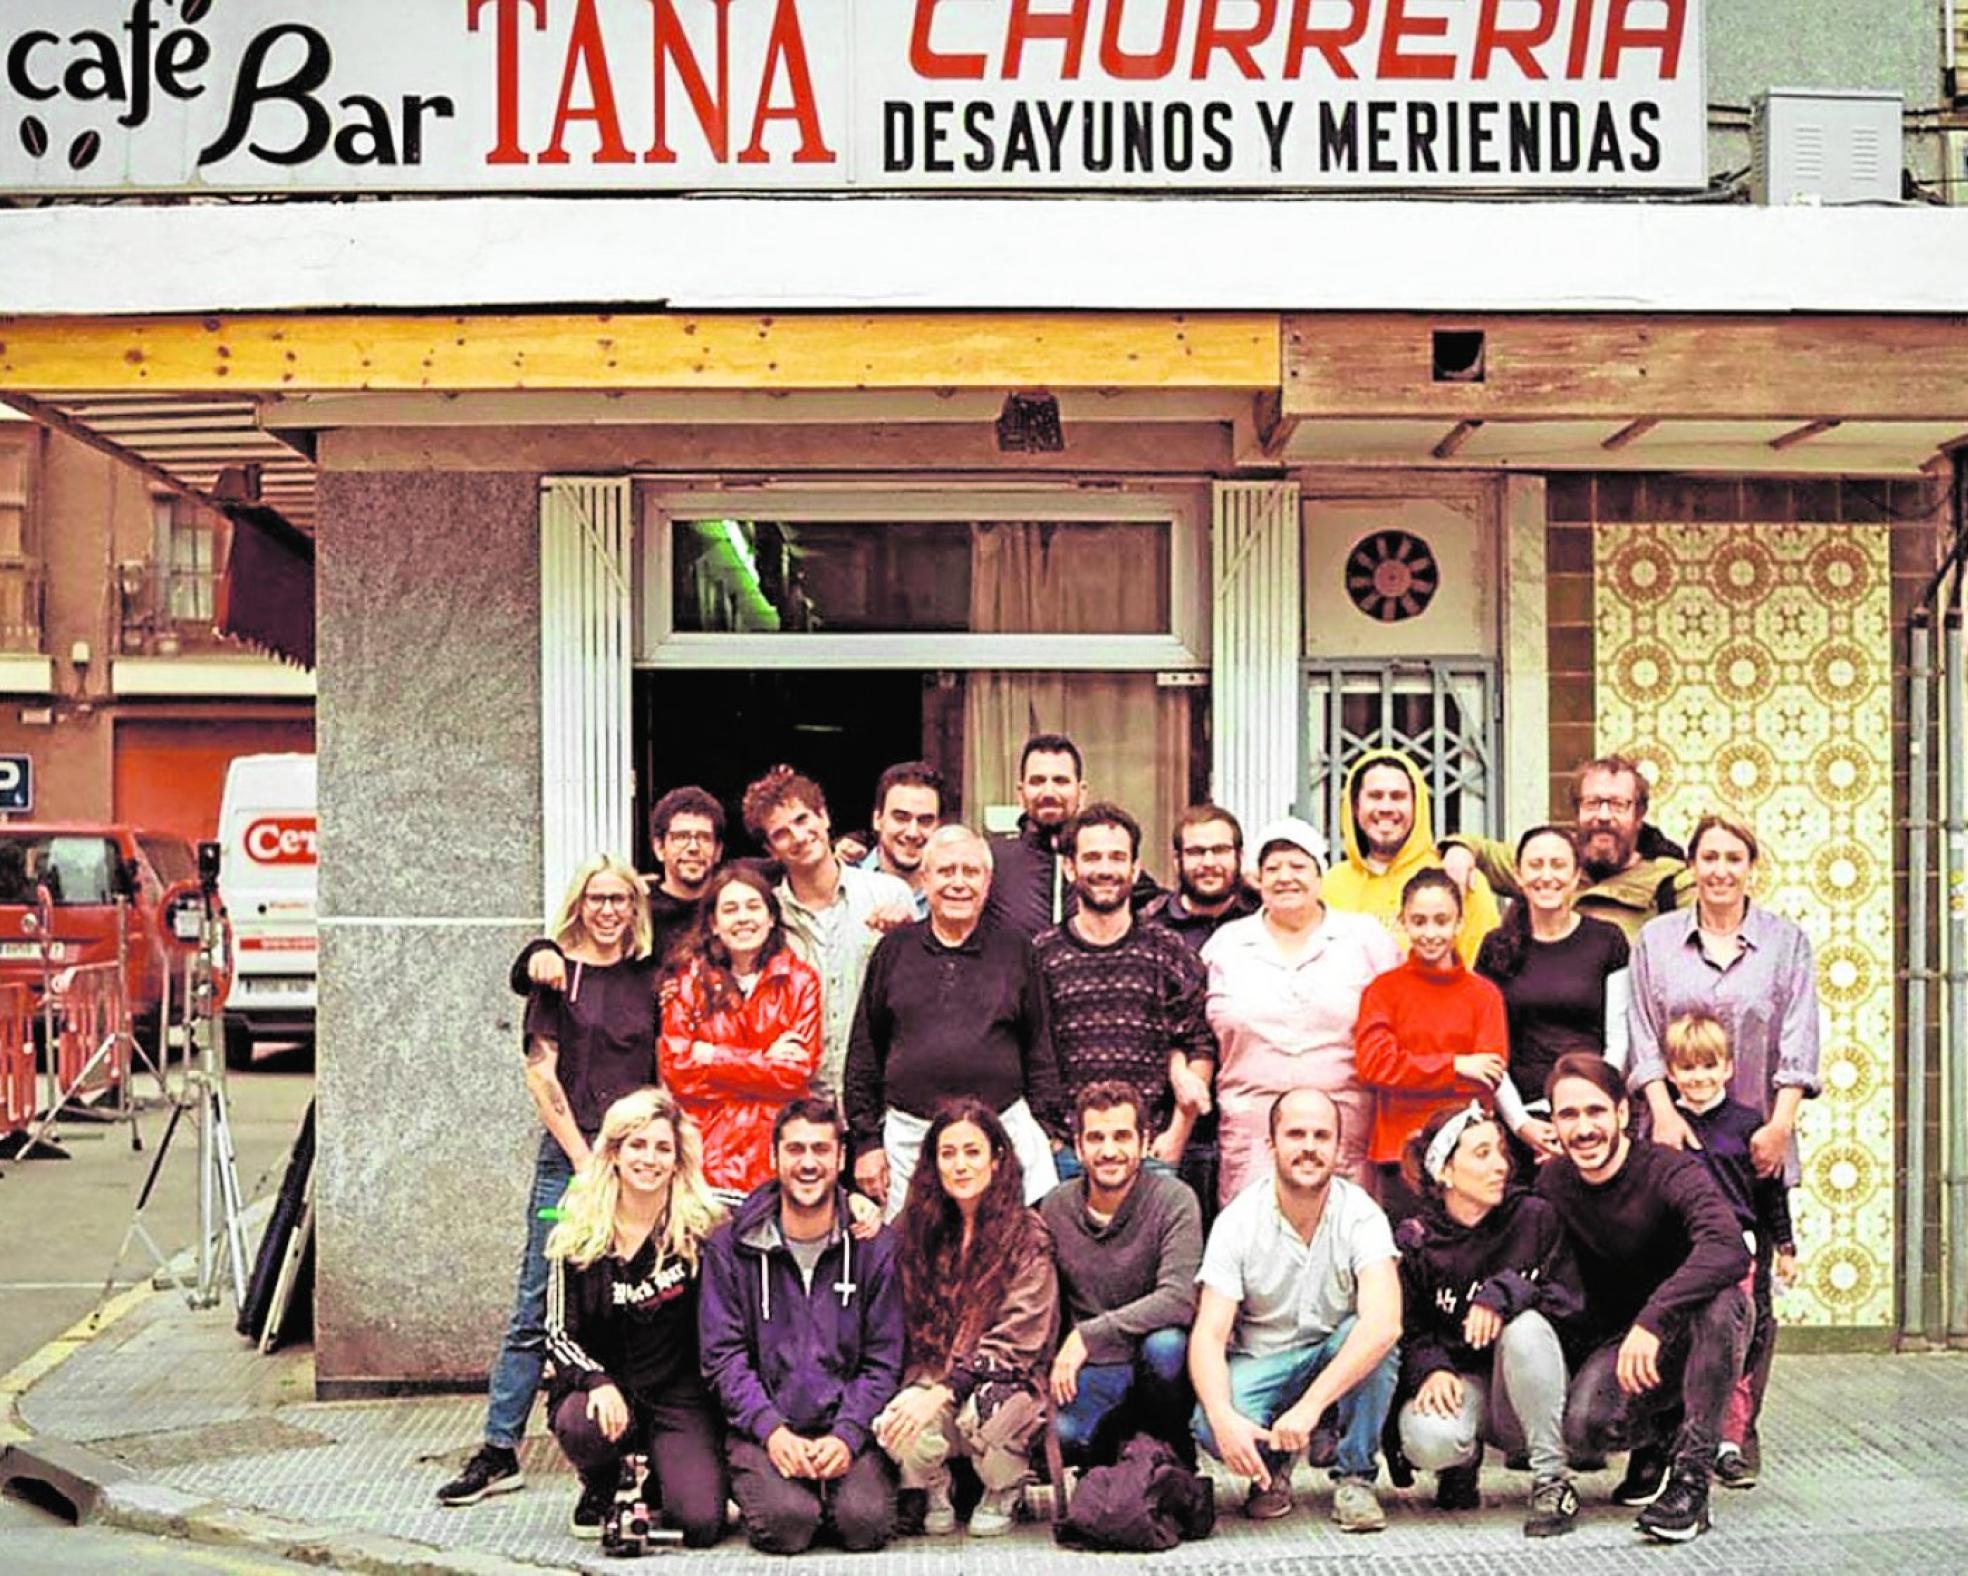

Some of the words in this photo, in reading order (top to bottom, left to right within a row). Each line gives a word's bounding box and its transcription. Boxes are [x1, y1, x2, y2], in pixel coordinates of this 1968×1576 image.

[908, 0, 1686, 80] CHURRERIA
[7, 0, 211, 128] café
[197, 24, 455, 167] Bar
[467, 0, 836, 164] TANA
[883, 101, 1233, 173] DESAYUNOS
[1256, 101, 1294, 172] Y
[1319, 101, 1660, 173] MERIENDAS
